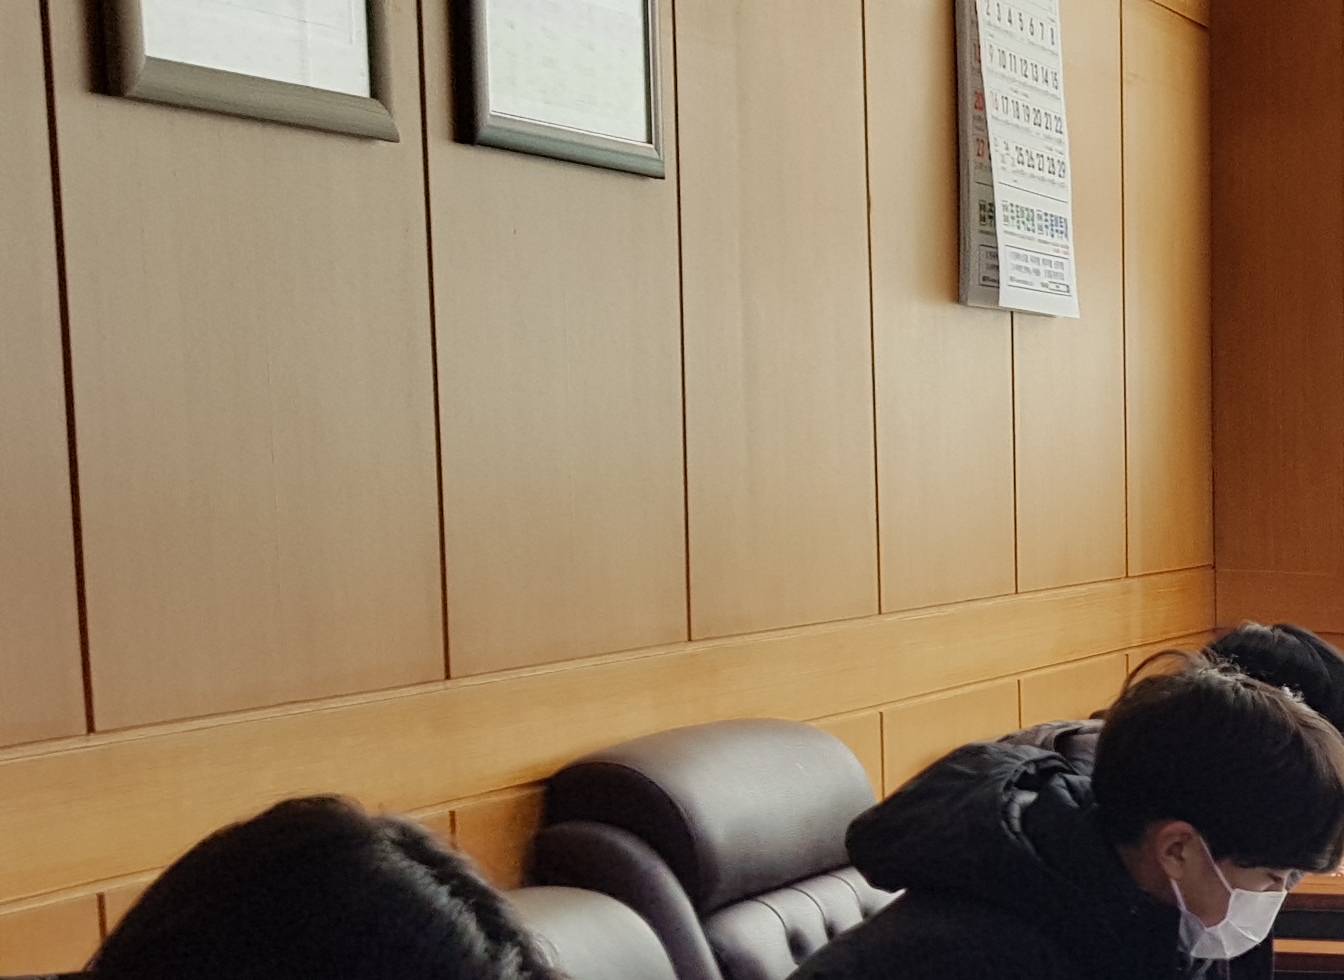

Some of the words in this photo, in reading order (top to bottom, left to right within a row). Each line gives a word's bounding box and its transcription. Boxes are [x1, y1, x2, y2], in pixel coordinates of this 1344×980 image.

[1007, 8, 1013, 25] 4
[1018, 12, 1024, 32] 5
[1029, 17, 1034, 36] 6
[1039, 22, 1044, 41] 7
[998, 48, 1007, 69] 10
[1009, 52, 1017, 74] 11
[1020, 58, 1028, 79] 12
[1001, 95, 1009, 115] 17
[1032, 107, 1042, 127] 20
[1044, 111, 1052, 130] 21
[1054, 114, 1063, 135] 22
